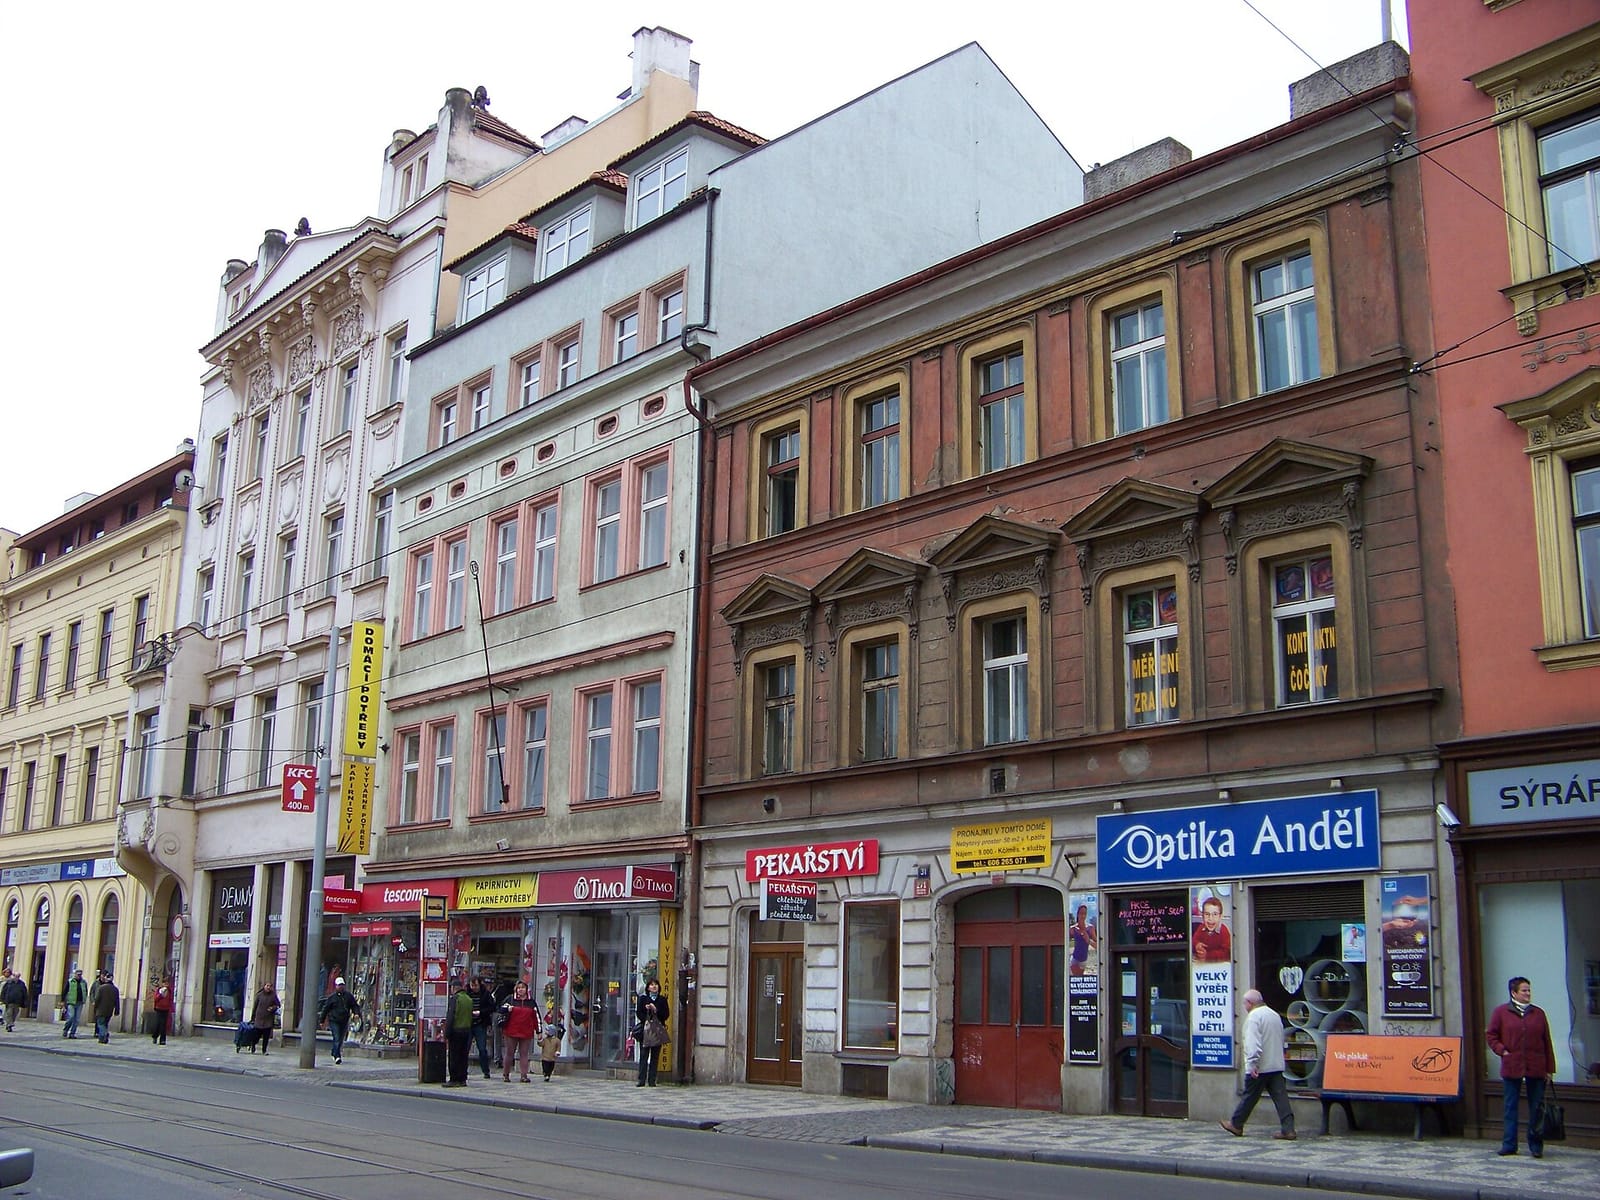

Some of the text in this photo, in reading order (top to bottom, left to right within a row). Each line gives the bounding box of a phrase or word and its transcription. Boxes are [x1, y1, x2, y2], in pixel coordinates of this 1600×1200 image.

[1286, 626, 1337, 655] KONTAKTN
[1133, 687, 1177, 713] ZRAKU
[287, 767, 313, 778] KFC
[287, 801, 302, 810] 400
[1001, 824, 1024, 834] TOMTO
[1124, 806, 1364, 869] Optika Anděl
[754, 841, 864, 877] PEKAŘSTVÍ
[768, 882, 816, 895] PEKAŘSTVÍ
[220, 885, 254, 909] DENNY
[226, 911, 244, 923] SHOES
[1195, 970, 1228, 981] VELKÝ
[1195, 983, 1228, 993] VÝBĚR
[1198, 996, 1226, 1006] BRÝLÍ
[1201, 1010, 1222, 1019] PRO
[1199, 1021, 1225, 1031] DĚTI!
